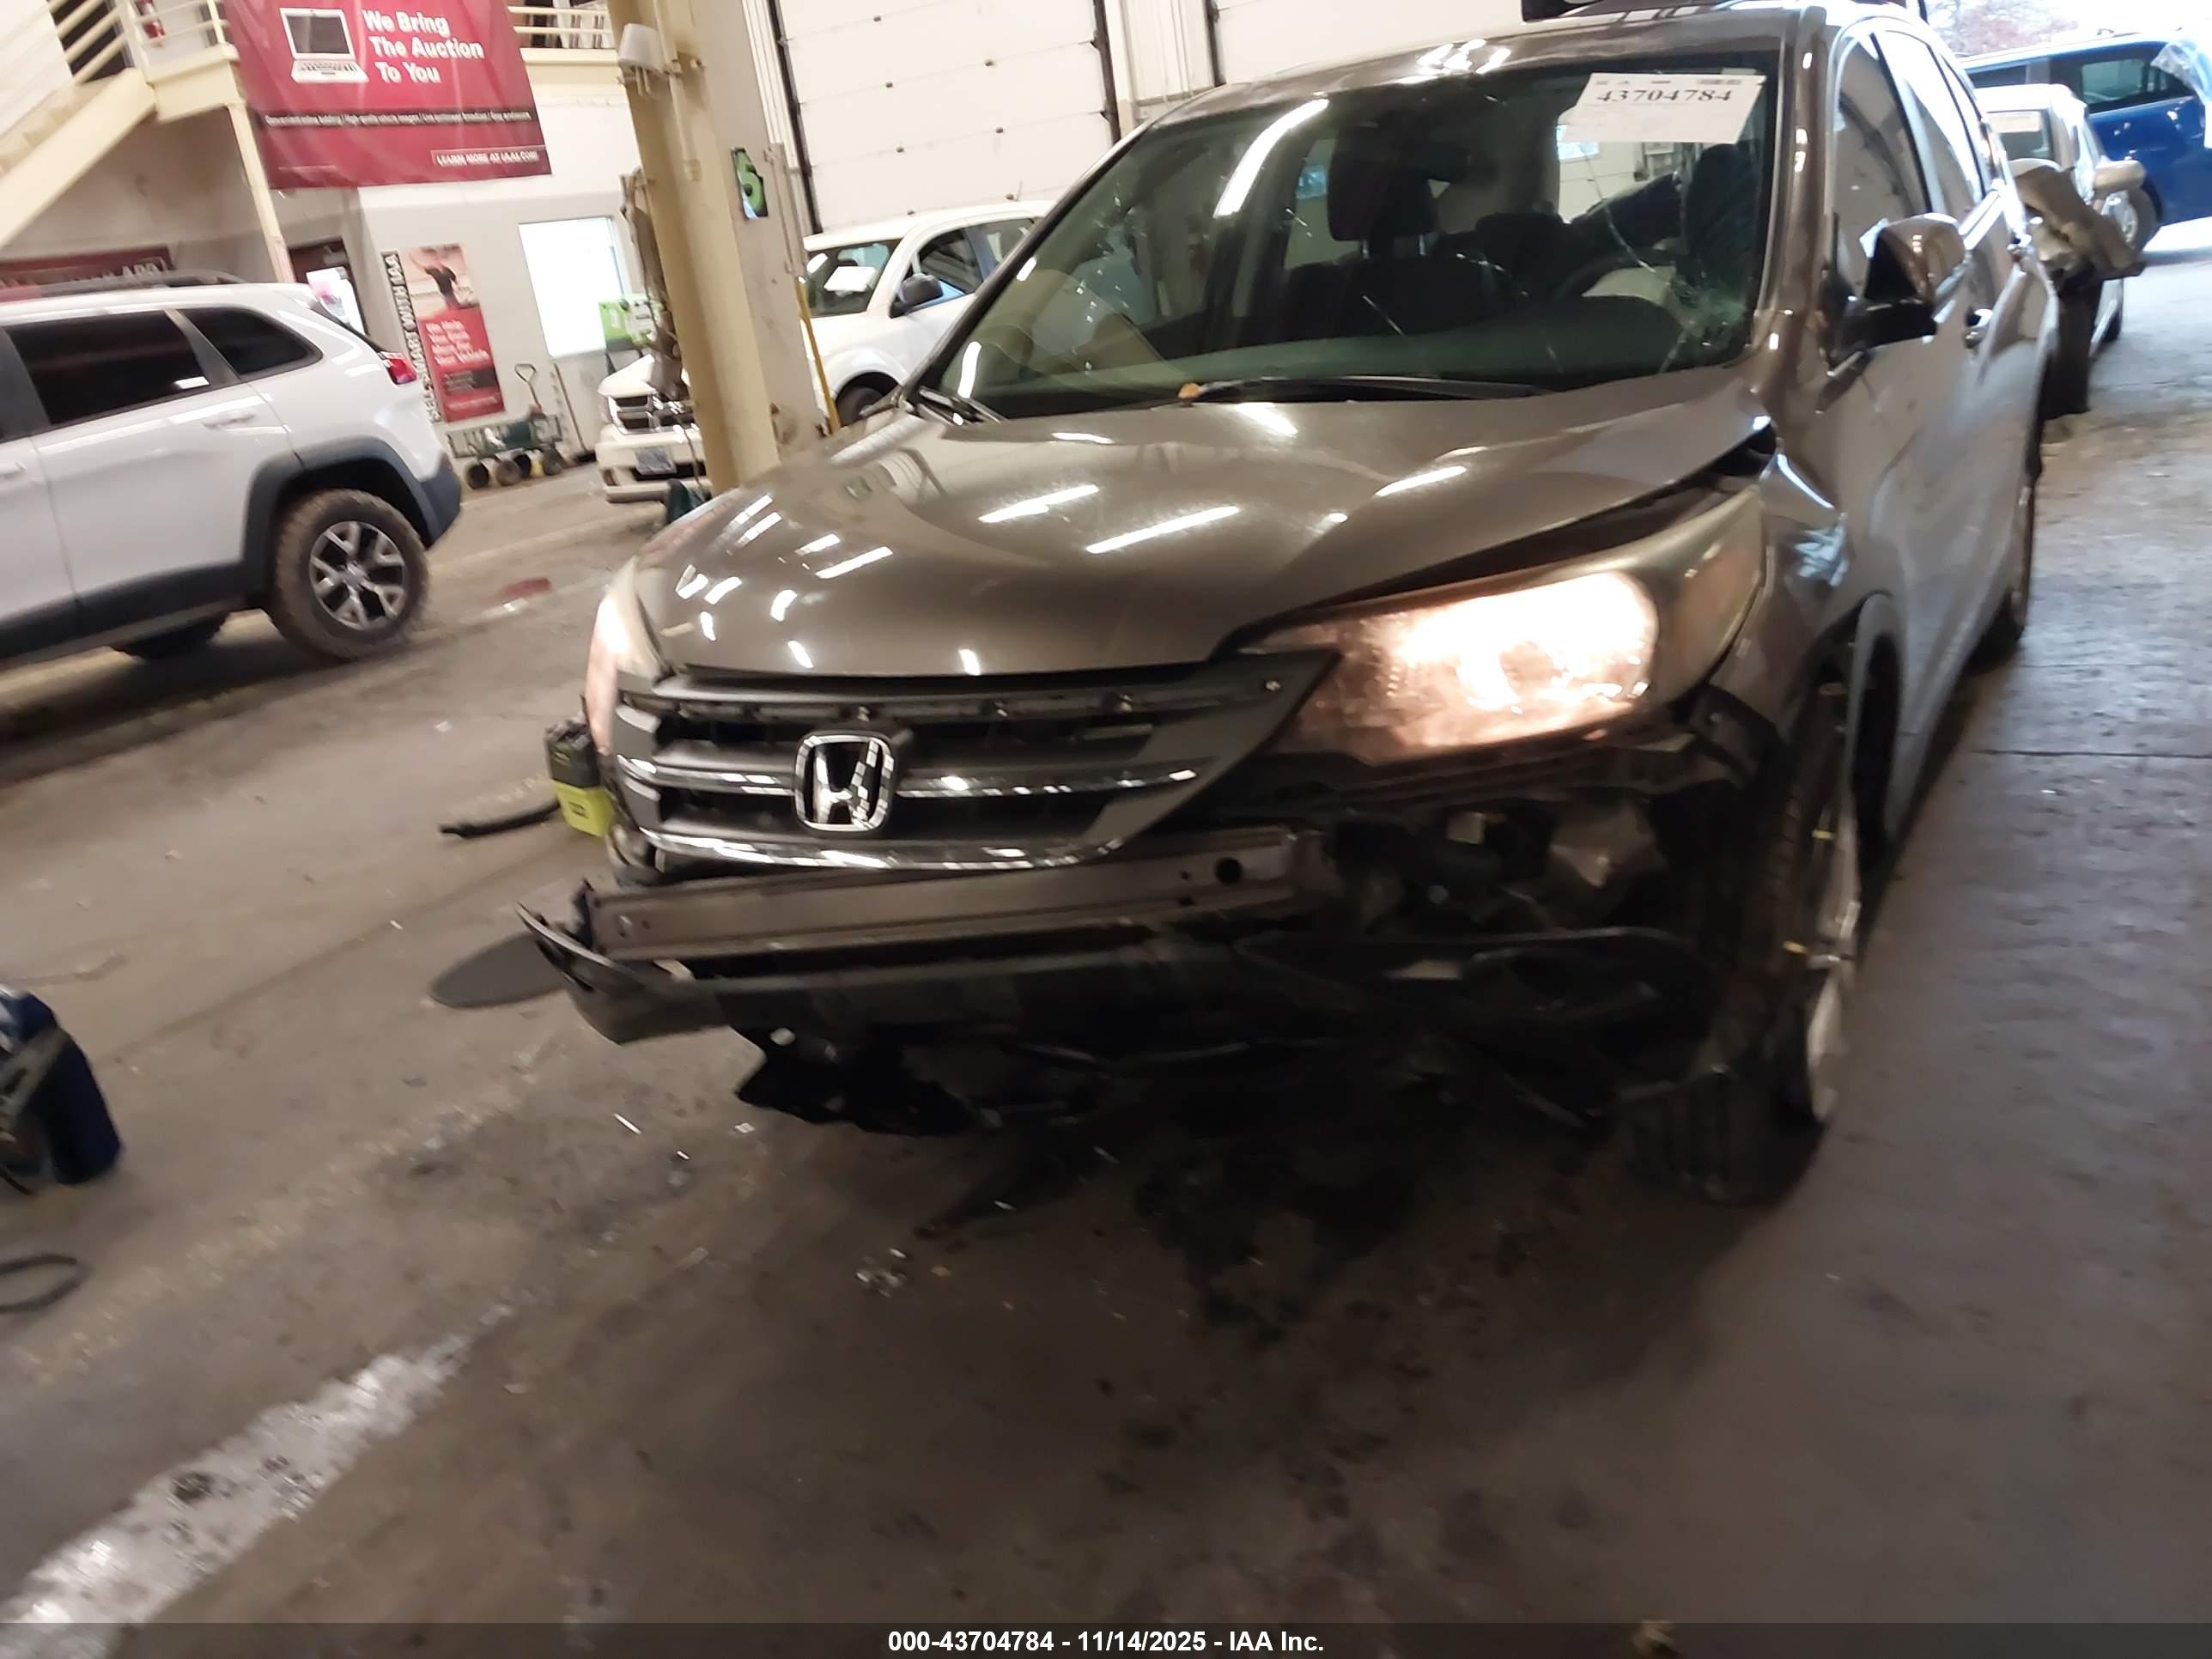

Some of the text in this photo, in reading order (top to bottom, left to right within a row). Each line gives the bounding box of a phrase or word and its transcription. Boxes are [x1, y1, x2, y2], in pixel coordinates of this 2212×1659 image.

[361, 10, 449, 37] We Bring
[369, 37, 484, 59] The Auction
[374, 62, 441, 83] To You
[1597, 88, 1734, 102] 43704784
[436, 154, 467, 167] LEARN
[465, 154, 490, 166] MORE
[489, 153, 502, 164] AT
[385, 254, 405, 285] IAA
[392, 286, 416, 331] WITH
